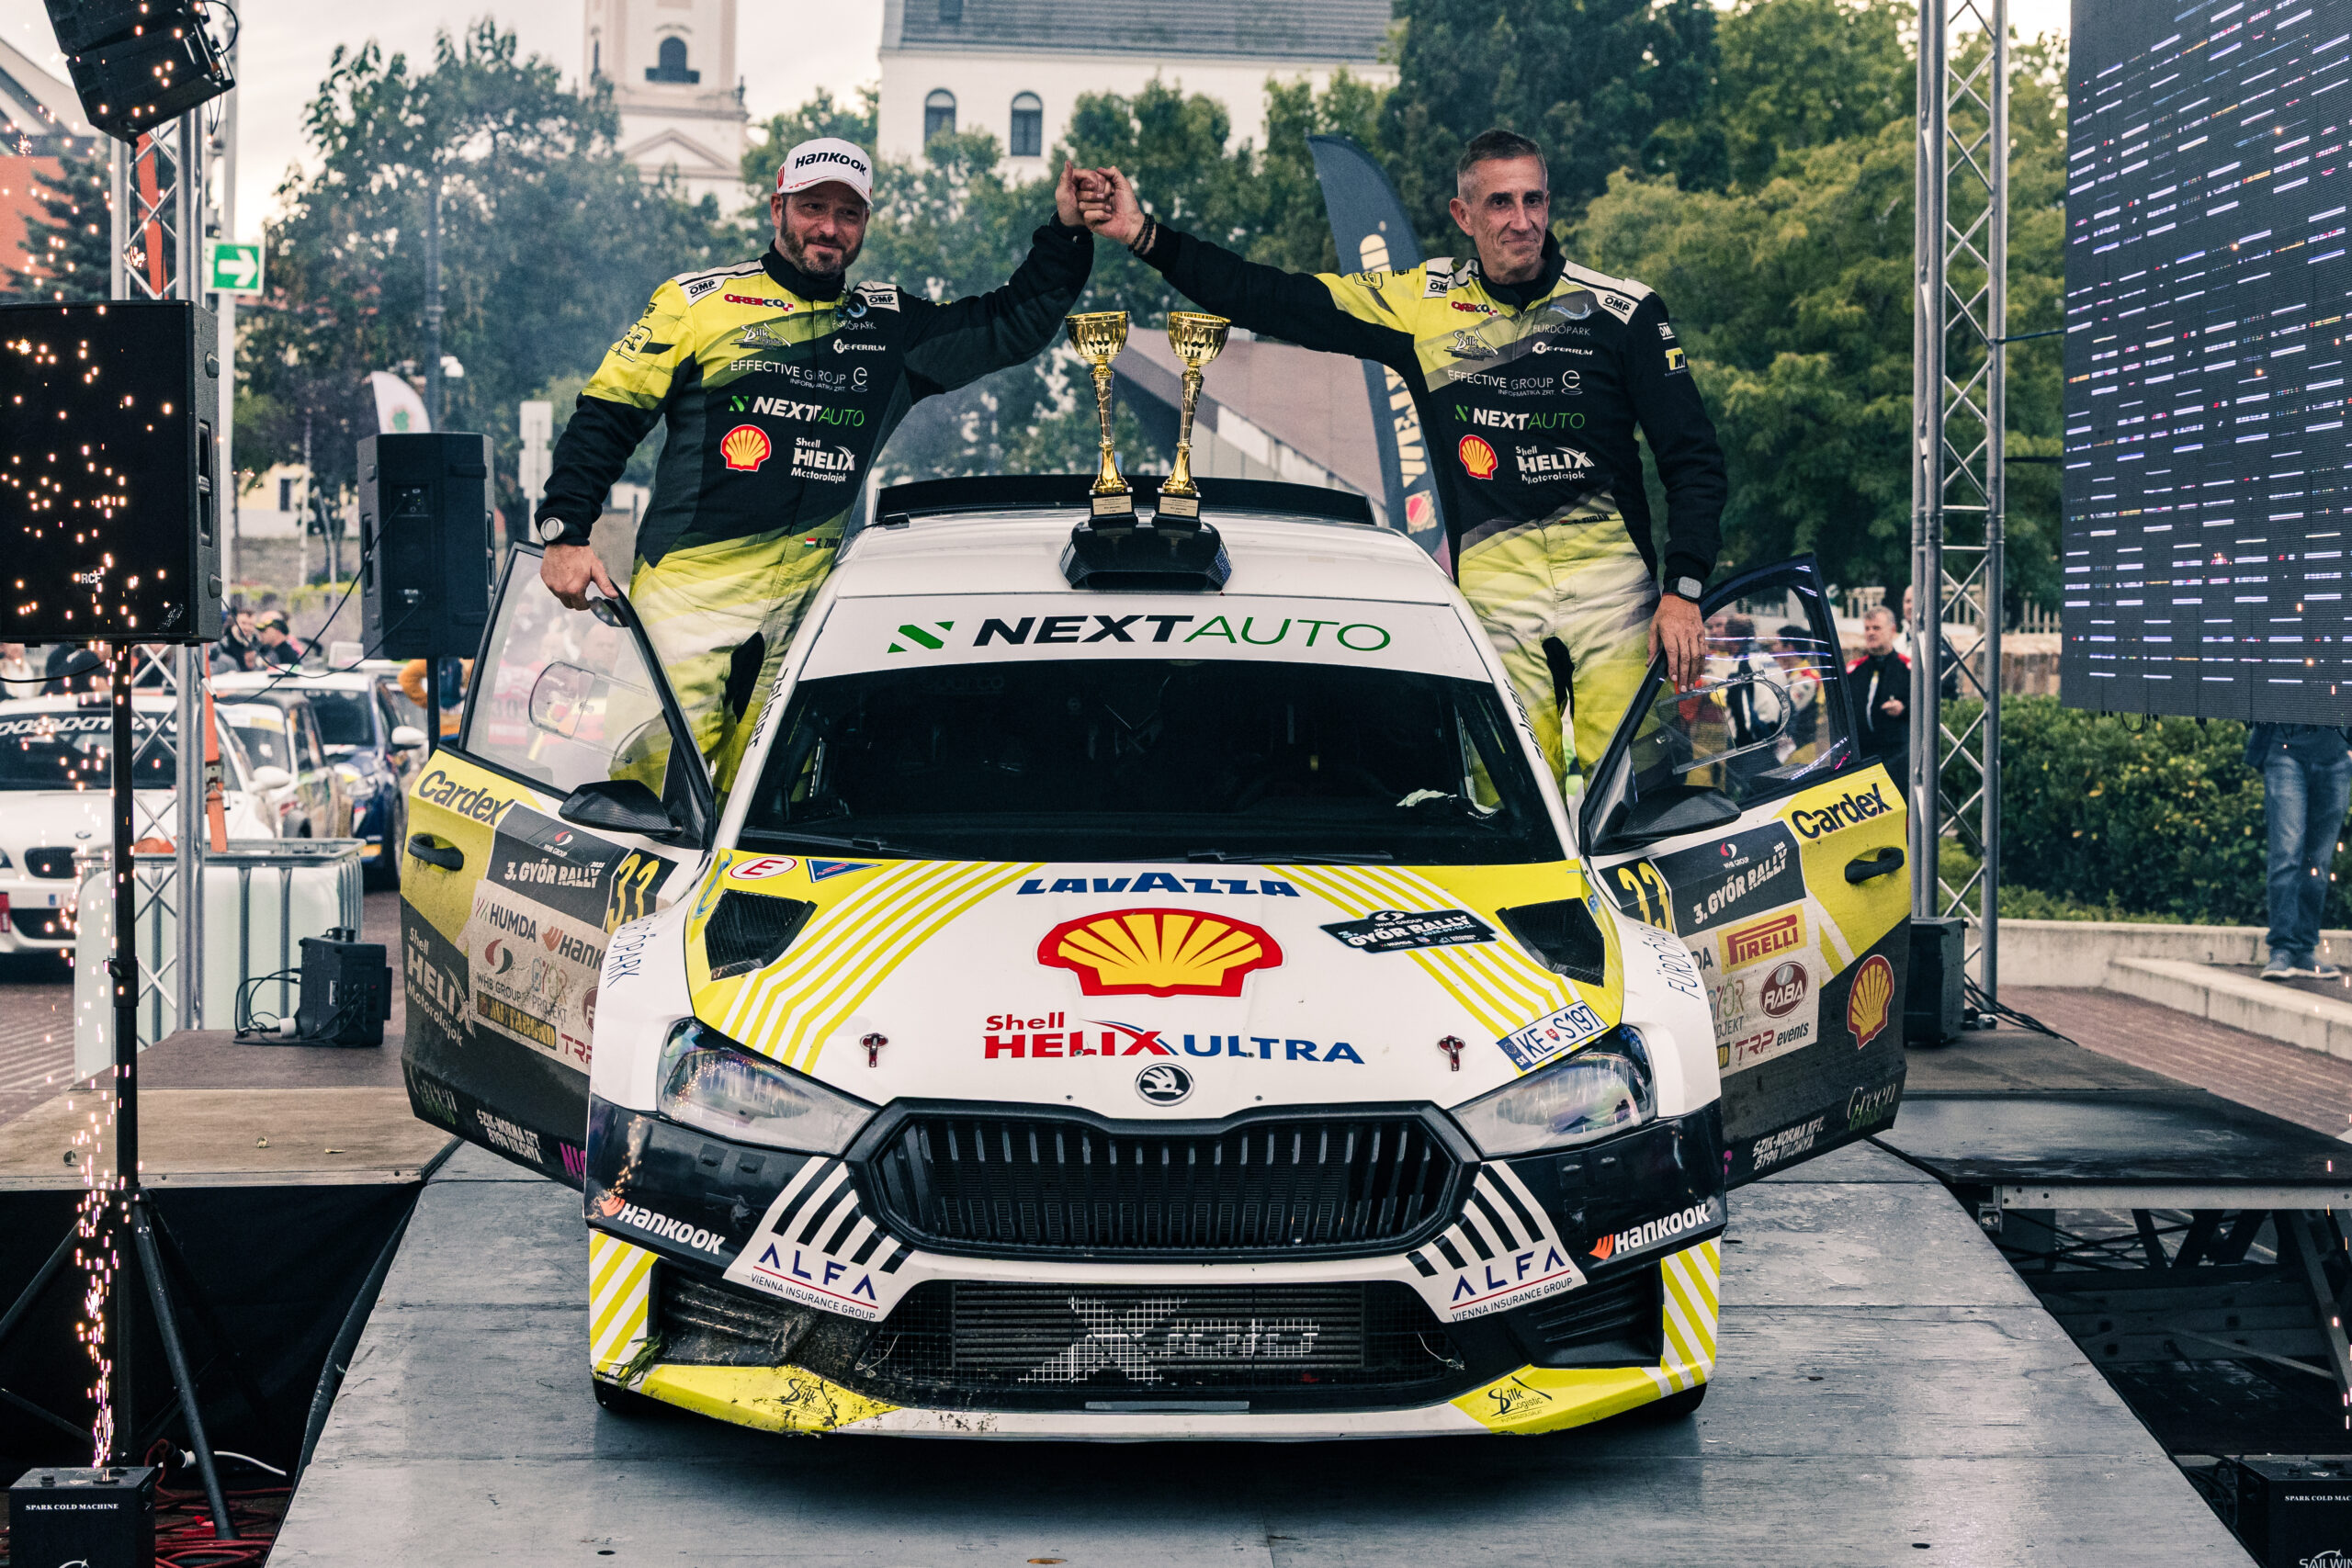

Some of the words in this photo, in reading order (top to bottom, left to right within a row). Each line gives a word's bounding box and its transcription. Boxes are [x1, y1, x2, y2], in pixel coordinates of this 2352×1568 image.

[690, 280, 715, 295] OMP
[868, 296, 894, 304] OMP
[1430, 282, 1448, 291] OM
[1604, 297, 1631, 312] OMP
[730, 359, 800, 378] EFFECTIVE
[1448, 369, 1507, 389] EFFECTIVE
[1510, 378, 1555, 390] GROUP
[796, 437, 821, 448] Shell
[1515, 446, 1537, 457] Shell
[793, 446, 856, 471] HELIX
[1516, 450, 1594, 474] HELIX
[1521, 471, 1586, 485] Motorolajok
[81, 573, 102, 584] RCF
[418, 770, 515, 827] Cardex
[1791, 782, 1894, 840] Cardex
[504, 862, 517, 881] 3.
[518, 858, 557, 885] GYŐR
[557, 866, 602, 888] RALLY
[741, 859, 786, 875] E
[606, 853, 661, 935] 33
[1015, 872, 1301, 898] LAVAZZA
[1693, 902, 1708, 925] 3.
[1707, 874, 1747, 915] GYŐR
[1747, 848, 1788, 891] RALLY
[489, 902, 537, 943] HUMDA
[1338, 931, 1359, 939] 3.
[1348, 927, 1411, 947] GYŐR
[1408, 915, 1472, 935] RALLY
[409, 927, 430, 956] Shell
[1726, 913, 1800, 966] PIRELLI
[407, 943, 476, 1039] HELIX
[477, 972, 493, 990] WHB
[495, 981, 522, 1003] GROUP
[407, 979, 464, 1048] Motorolajok
[985, 1011, 1065, 1031] Shell
[1714, 1015, 1745, 1040] OJEKT
[982, 1023, 1171, 1060] HELIX
[1182, 1034, 1366, 1065] ULTRA
[1516, 1027, 1555, 1058] KE
[1553, 1005, 1600, 1039] S197
[1735, 1029, 1775, 1062] TRP
[1777, 1021, 1809, 1047] events
[1515, 1055, 1529, 1066] SK
[1752, 1123, 1806, 1157] SZIK-NORMA
[758, 1242, 877, 1302] ALFA
[1452, 1246, 1566, 1302] ALFA
[750, 1272, 785, 1293] VIENNA
[786, 1285, 840, 1312] INSURANCE
[841, 1303, 876, 1322] GROUP
[1452, 1303, 1489, 1322] VIENNA
[1490, 1287, 1543, 1312] INSURANCE
[1544, 1277, 1573, 1296] GROUP
[1487, 1387, 1524, 1416] Silk
[25, 1503, 53, 1511] SPARK
[53, 1503, 78, 1511] COLD
[79, 1502, 119, 1510] MACHINE
